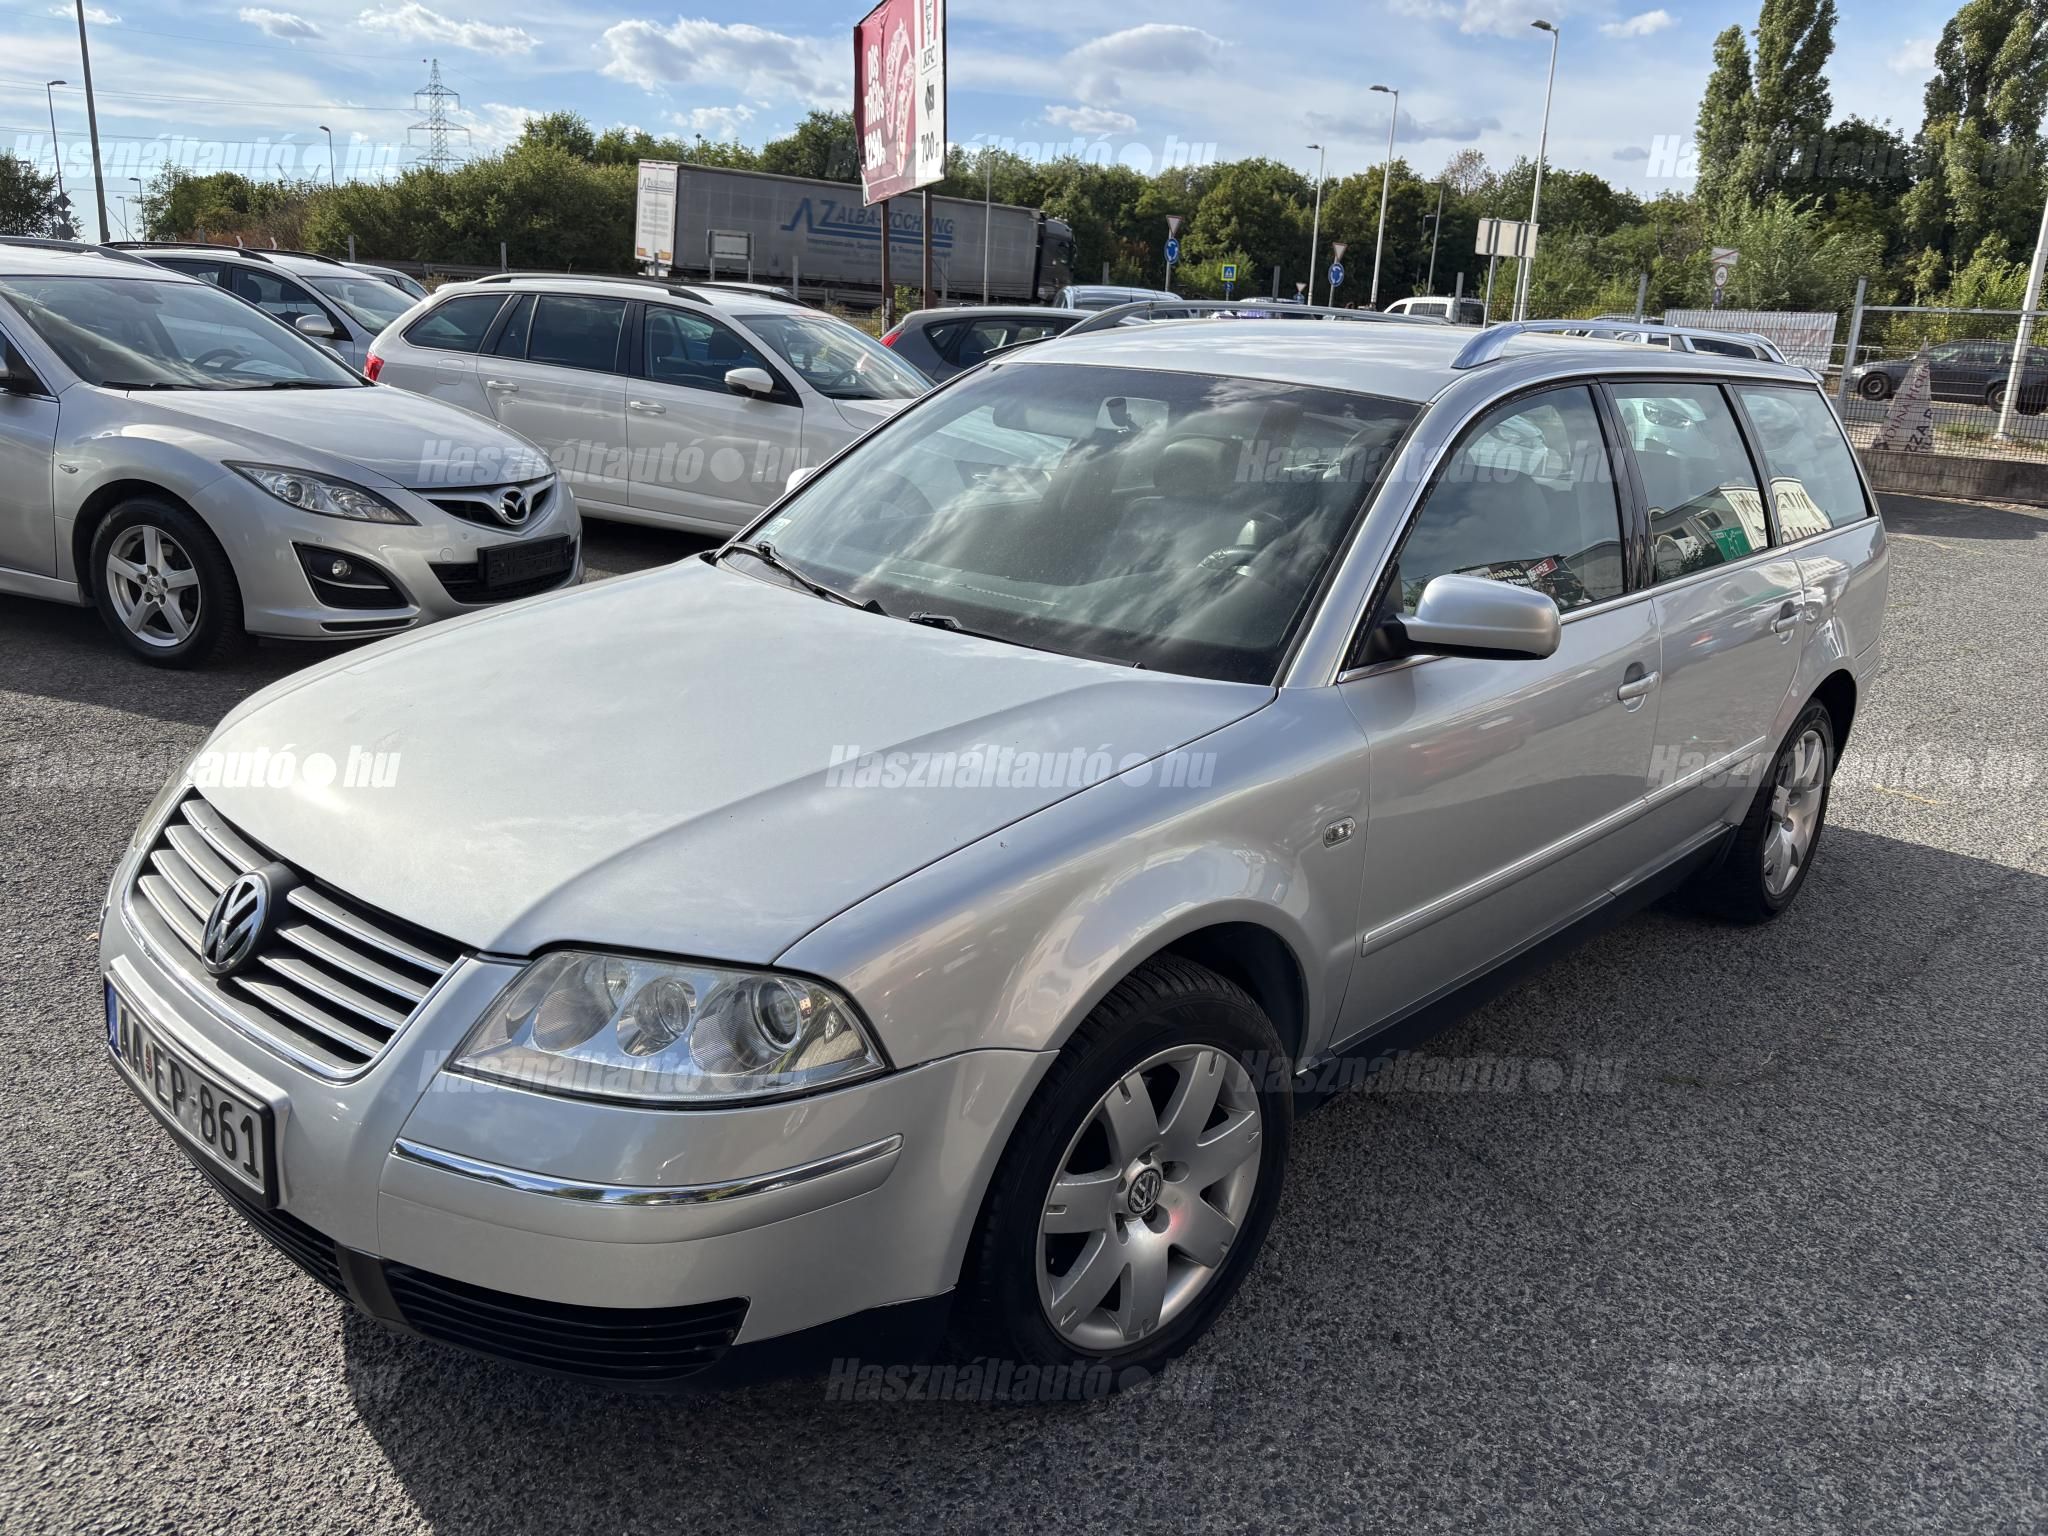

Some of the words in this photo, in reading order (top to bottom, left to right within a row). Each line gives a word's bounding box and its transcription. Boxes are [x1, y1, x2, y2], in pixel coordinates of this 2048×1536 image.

[922, 45, 935, 69] KFC
[921, 131, 935, 164] 700
[153, 1041, 259, 1179] EP-861
